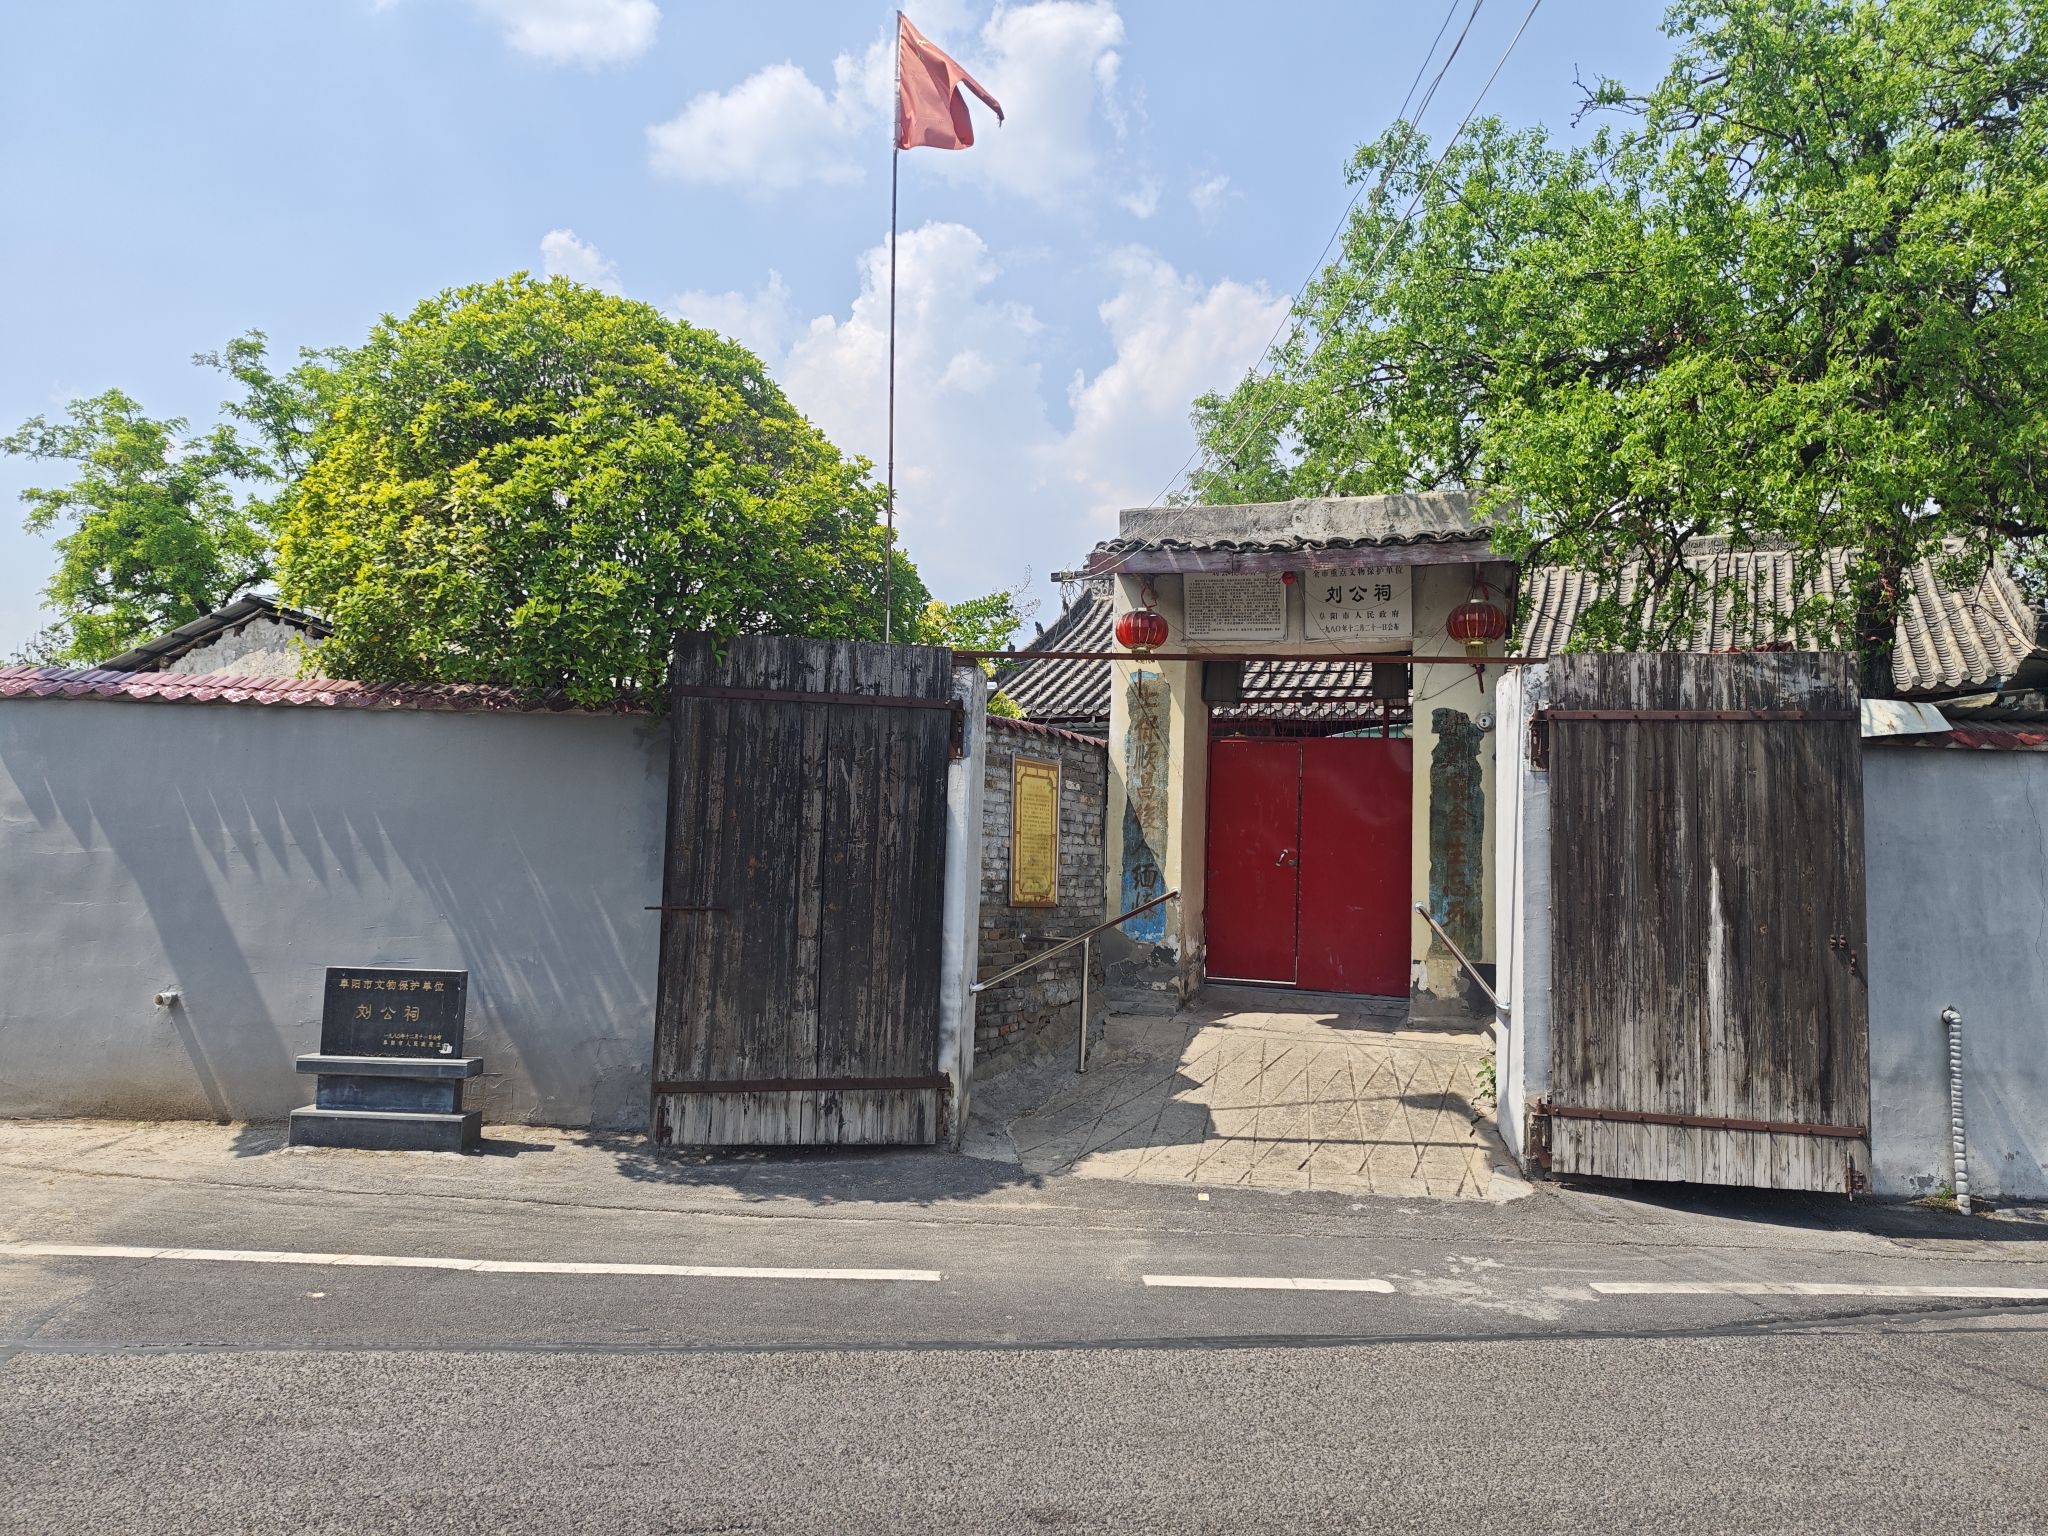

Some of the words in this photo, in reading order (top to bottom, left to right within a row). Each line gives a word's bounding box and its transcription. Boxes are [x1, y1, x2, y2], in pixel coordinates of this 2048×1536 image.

[1325, 583, 1392, 604] 刘公祠
[1319, 610, 1400, 621] 阜阳市人民政府
[339, 978, 444, 991] 阜阳市文物保护单位
[356, 1003, 420, 1022] 刘公祠
